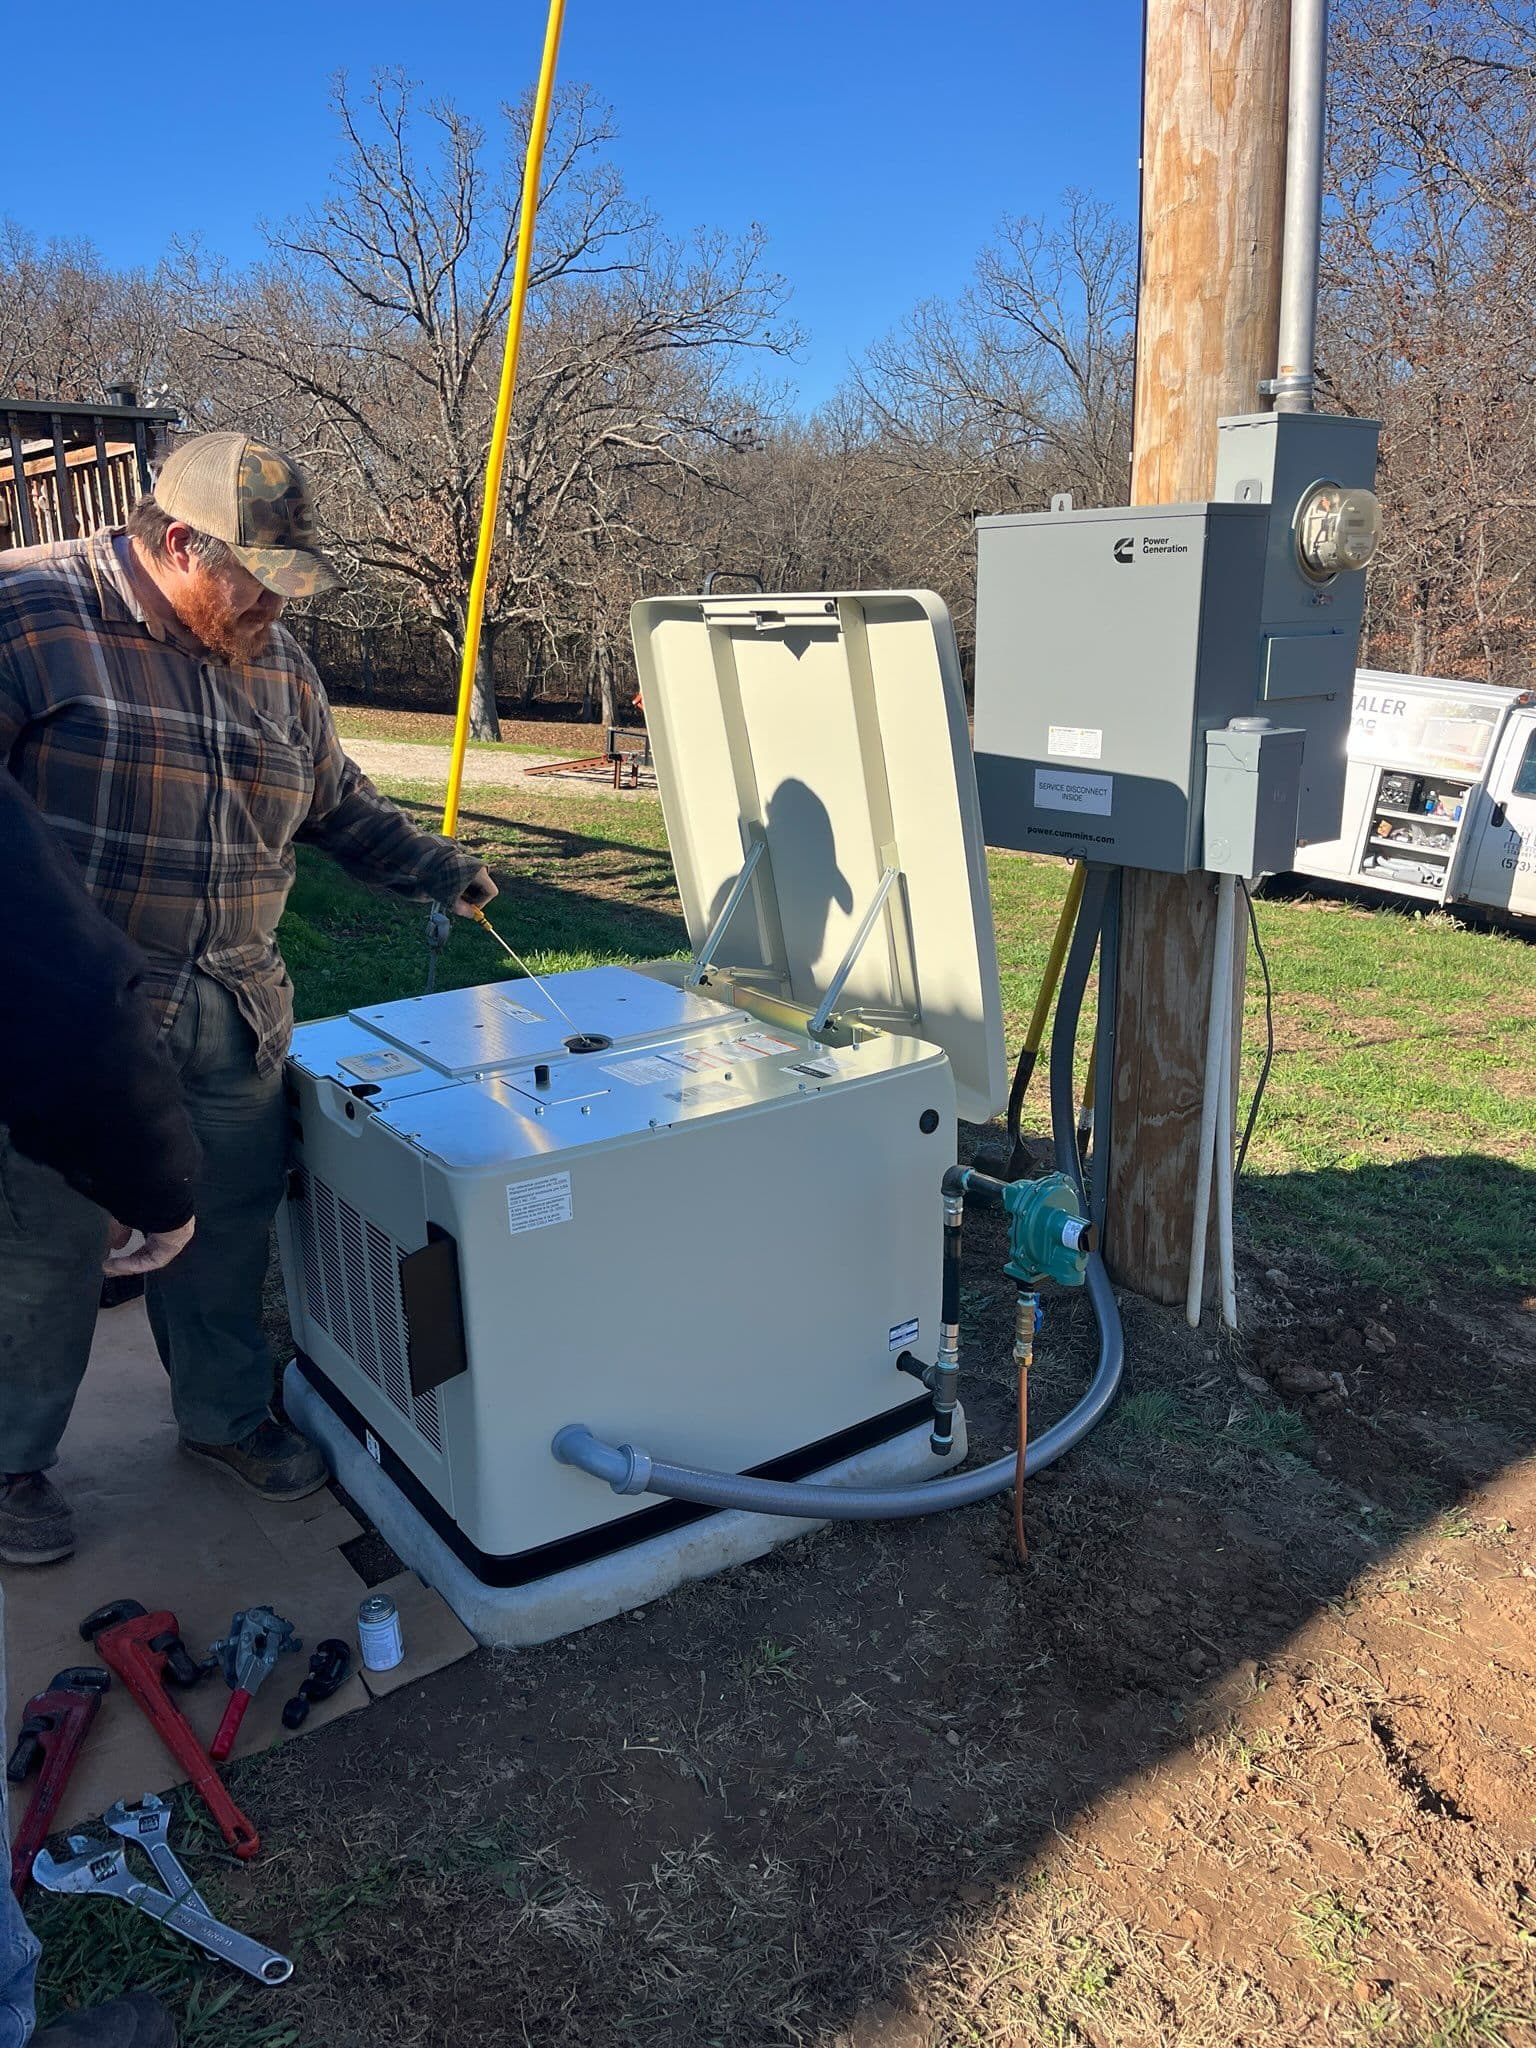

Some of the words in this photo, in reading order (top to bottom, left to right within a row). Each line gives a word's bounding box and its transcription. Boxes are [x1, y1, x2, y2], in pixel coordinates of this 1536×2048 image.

[1143, 537, 1169, 545] Power
[1142, 545, 1188, 554] Generation
[1353, 695, 1407, 716] ALER
[1039, 782, 1065, 792] SERVICE
[1065, 785, 1108, 796] DISCONNECT
[1061, 793, 1083, 802] INSIDE
[1027, 826, 1115, 844] power.cummins.com
